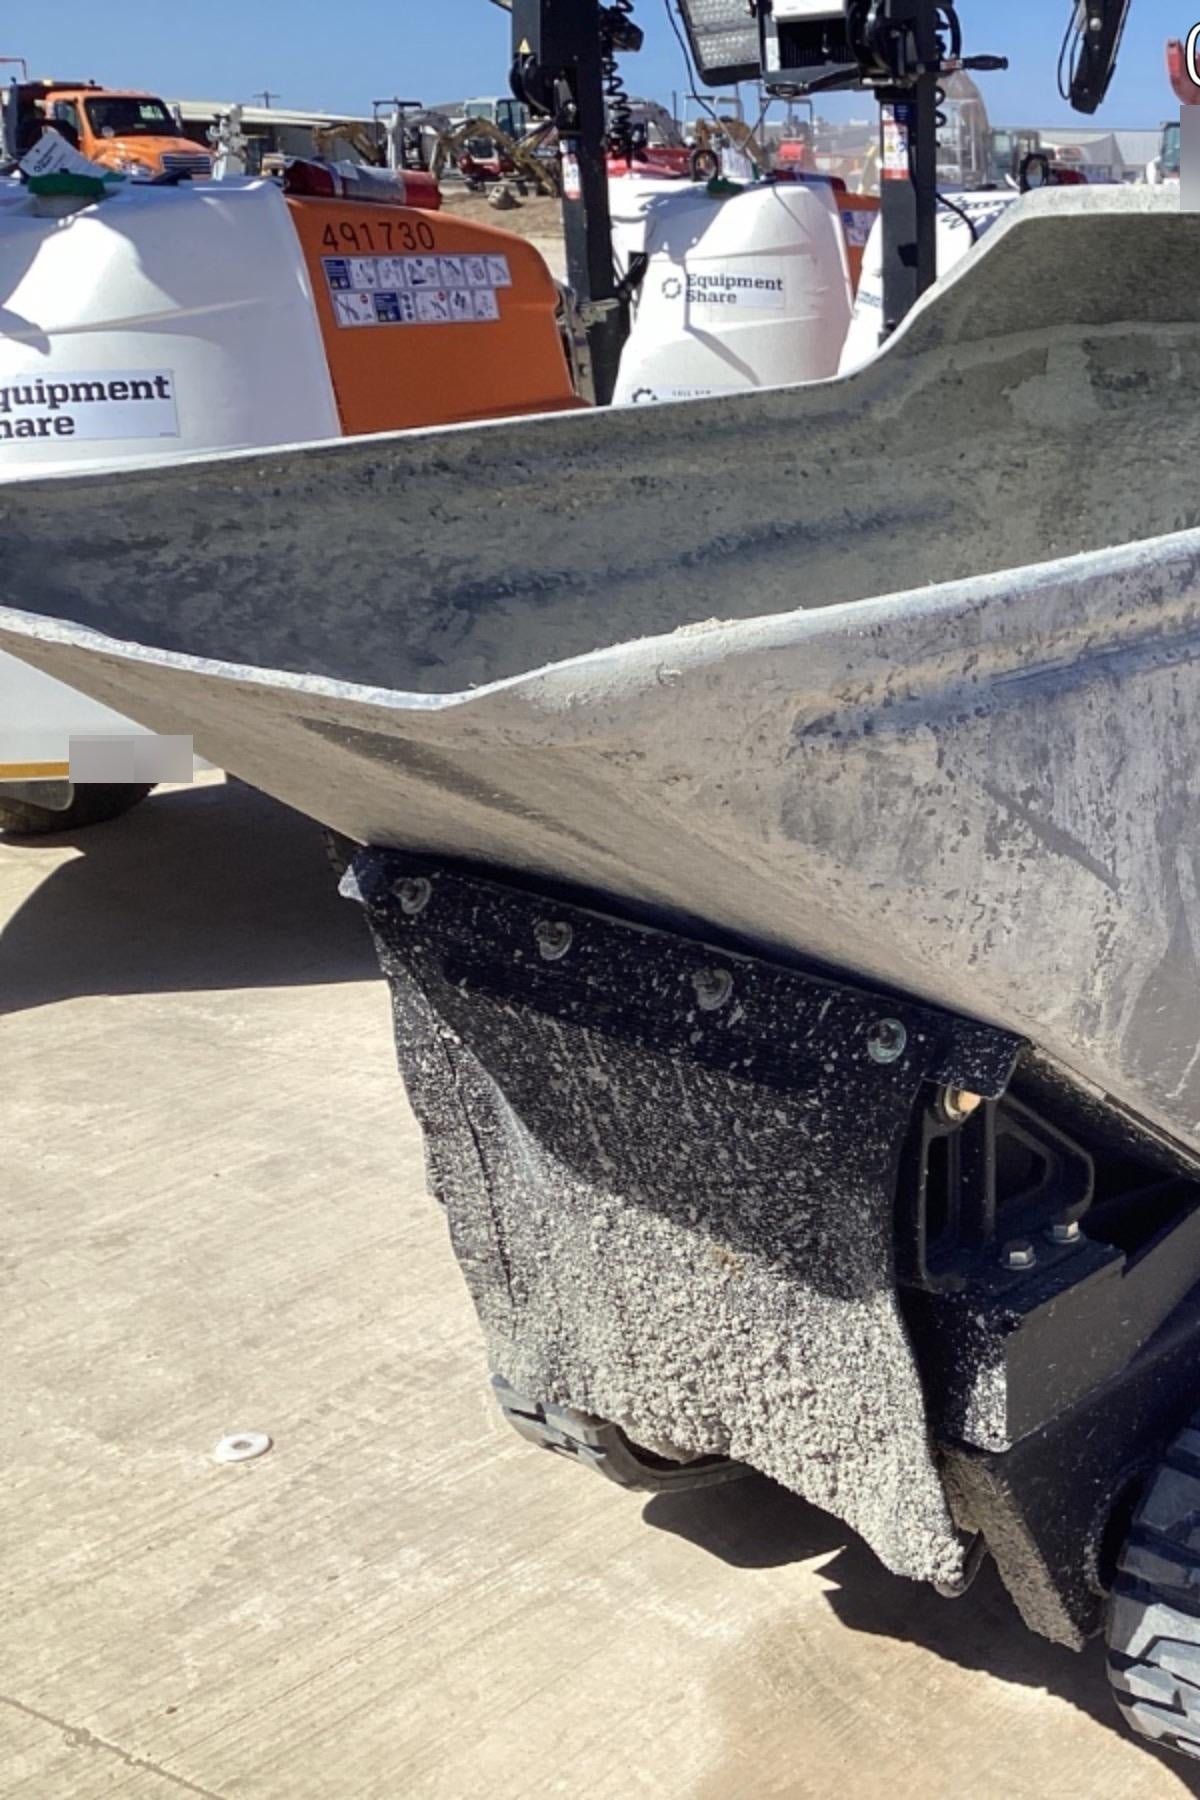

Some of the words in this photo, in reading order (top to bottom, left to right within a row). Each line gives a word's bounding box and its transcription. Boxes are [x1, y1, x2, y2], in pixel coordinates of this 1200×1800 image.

[322, 222, 435, 251] 491730
[686, 273, 784, 291] Equipment
[685, 289, 738, 304] Share
